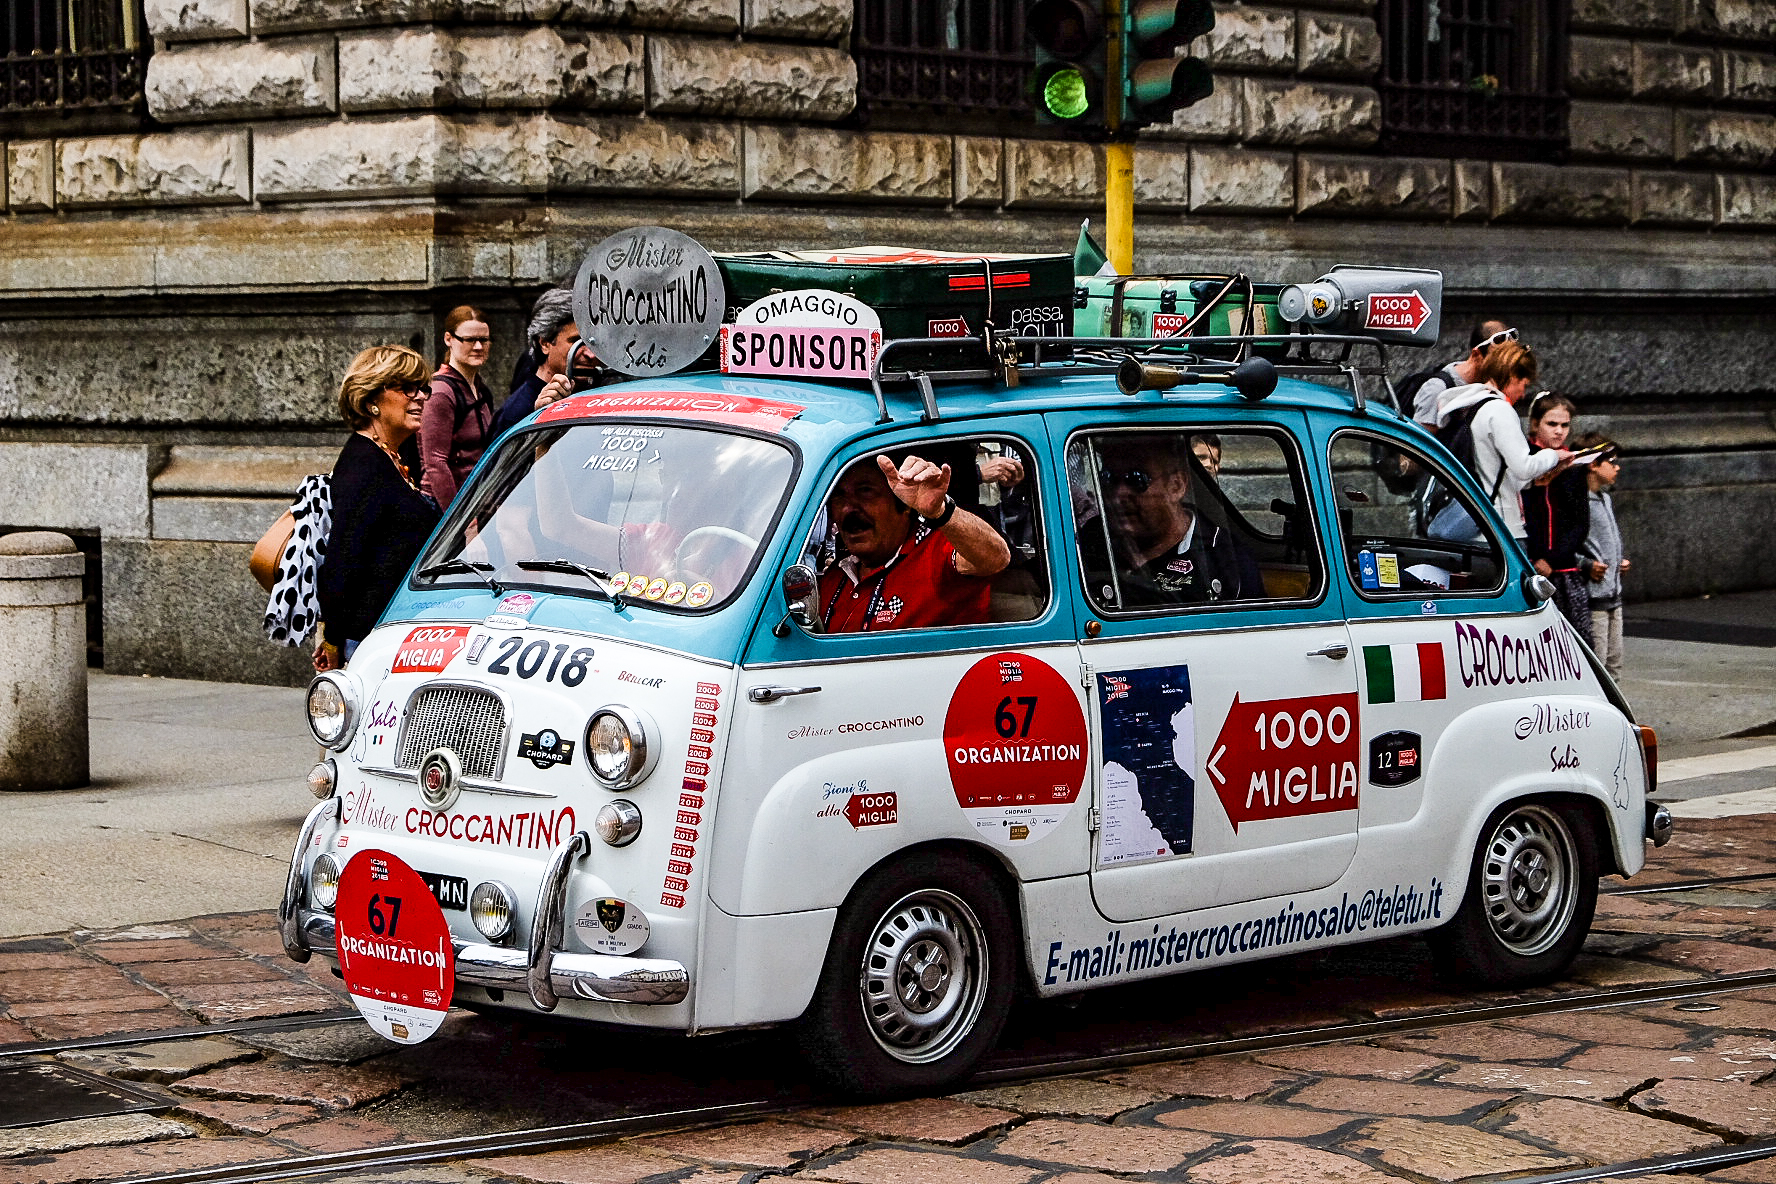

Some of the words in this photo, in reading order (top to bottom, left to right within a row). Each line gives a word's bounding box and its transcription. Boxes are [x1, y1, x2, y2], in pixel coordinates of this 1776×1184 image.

[606, 235, 686, 272] Mister
[588, 265, 708, 326] CROCCANTINO
[755, 295, 858, 325] OMAGGIO
[1375, 299, 1411, 310] 1000
[1011, 307, 1064, 328] passa
[1156, 317, 1182, 327] 1000
[1370, 314, 1413, 325] MIGLIA
[933, 323, 959, 333] 1000
[625, 339, 668, 369] Salò
[731, 331, 867, 371] SPONSOR
[586, 398, 740, 412] ORGANIZATION
[601, 436, 648, 452] 1000
[582, 454, 638, 472] MIGLIA
[411, 629, 456, 642] 1000
[395, 648, 444, 667] MIGLIA
[488, 636, 595, 688] 2018
[1455, 618, 1582, 689] CROCCANTINO
[697, 685, 717, 694] 2004
[695, 700, 715, 710] 2005
[368, 700, 398, 729] Salò
[693, 716, 713, 725] 2006
[995, 695, 1039, 738] 67
[1514, 703, 1592, 740] Mister
[787, 725, 834, 740] Mister
[838, 715, 925, 734] CROCCANTINO
[1255, 706, 1351, 750] 1000
[691, 732, 710, 741] 2007
[526, 750, 563, 761] CHOPARD
[688, 748, 708, 758] 2008
[954, 744, 1080, 764] ORGANIZATION
[1377, 751, 1392, 769] 12
[1551, 744, 1580, 772] Salò
[686, 765, 705, 774] 2009
[1246, 761, 1357, 809] MIGLIA
[679, 797, 700, 807] 2011
[860, 795, 894, 808] 1000
[342, 781, 399, 832] Mister
[405, 806, 576, 850] CROCCANTINO
[677, 814, 697, 824] 2012
[816, 804, 841, 818] alla
[858, 810, 897, 824] MIGLIA
[674, 831, 694, 840] 2013
[672, 847, 691, 857] 2014
[669, 864, 687, 873] 2015
[440, 879, 465, 904] MN
[664, 880, 684, 890] 2016
[661, 896, 681, 907] 2017
[367, 893, 402, 937] 67
[1043, 930, 1124, 986] E-mail:
[1126, 877, 1443, 973] mistercroccantinosalo@teletu.it
[341, 935, 446, 969] ORGANIZATION
